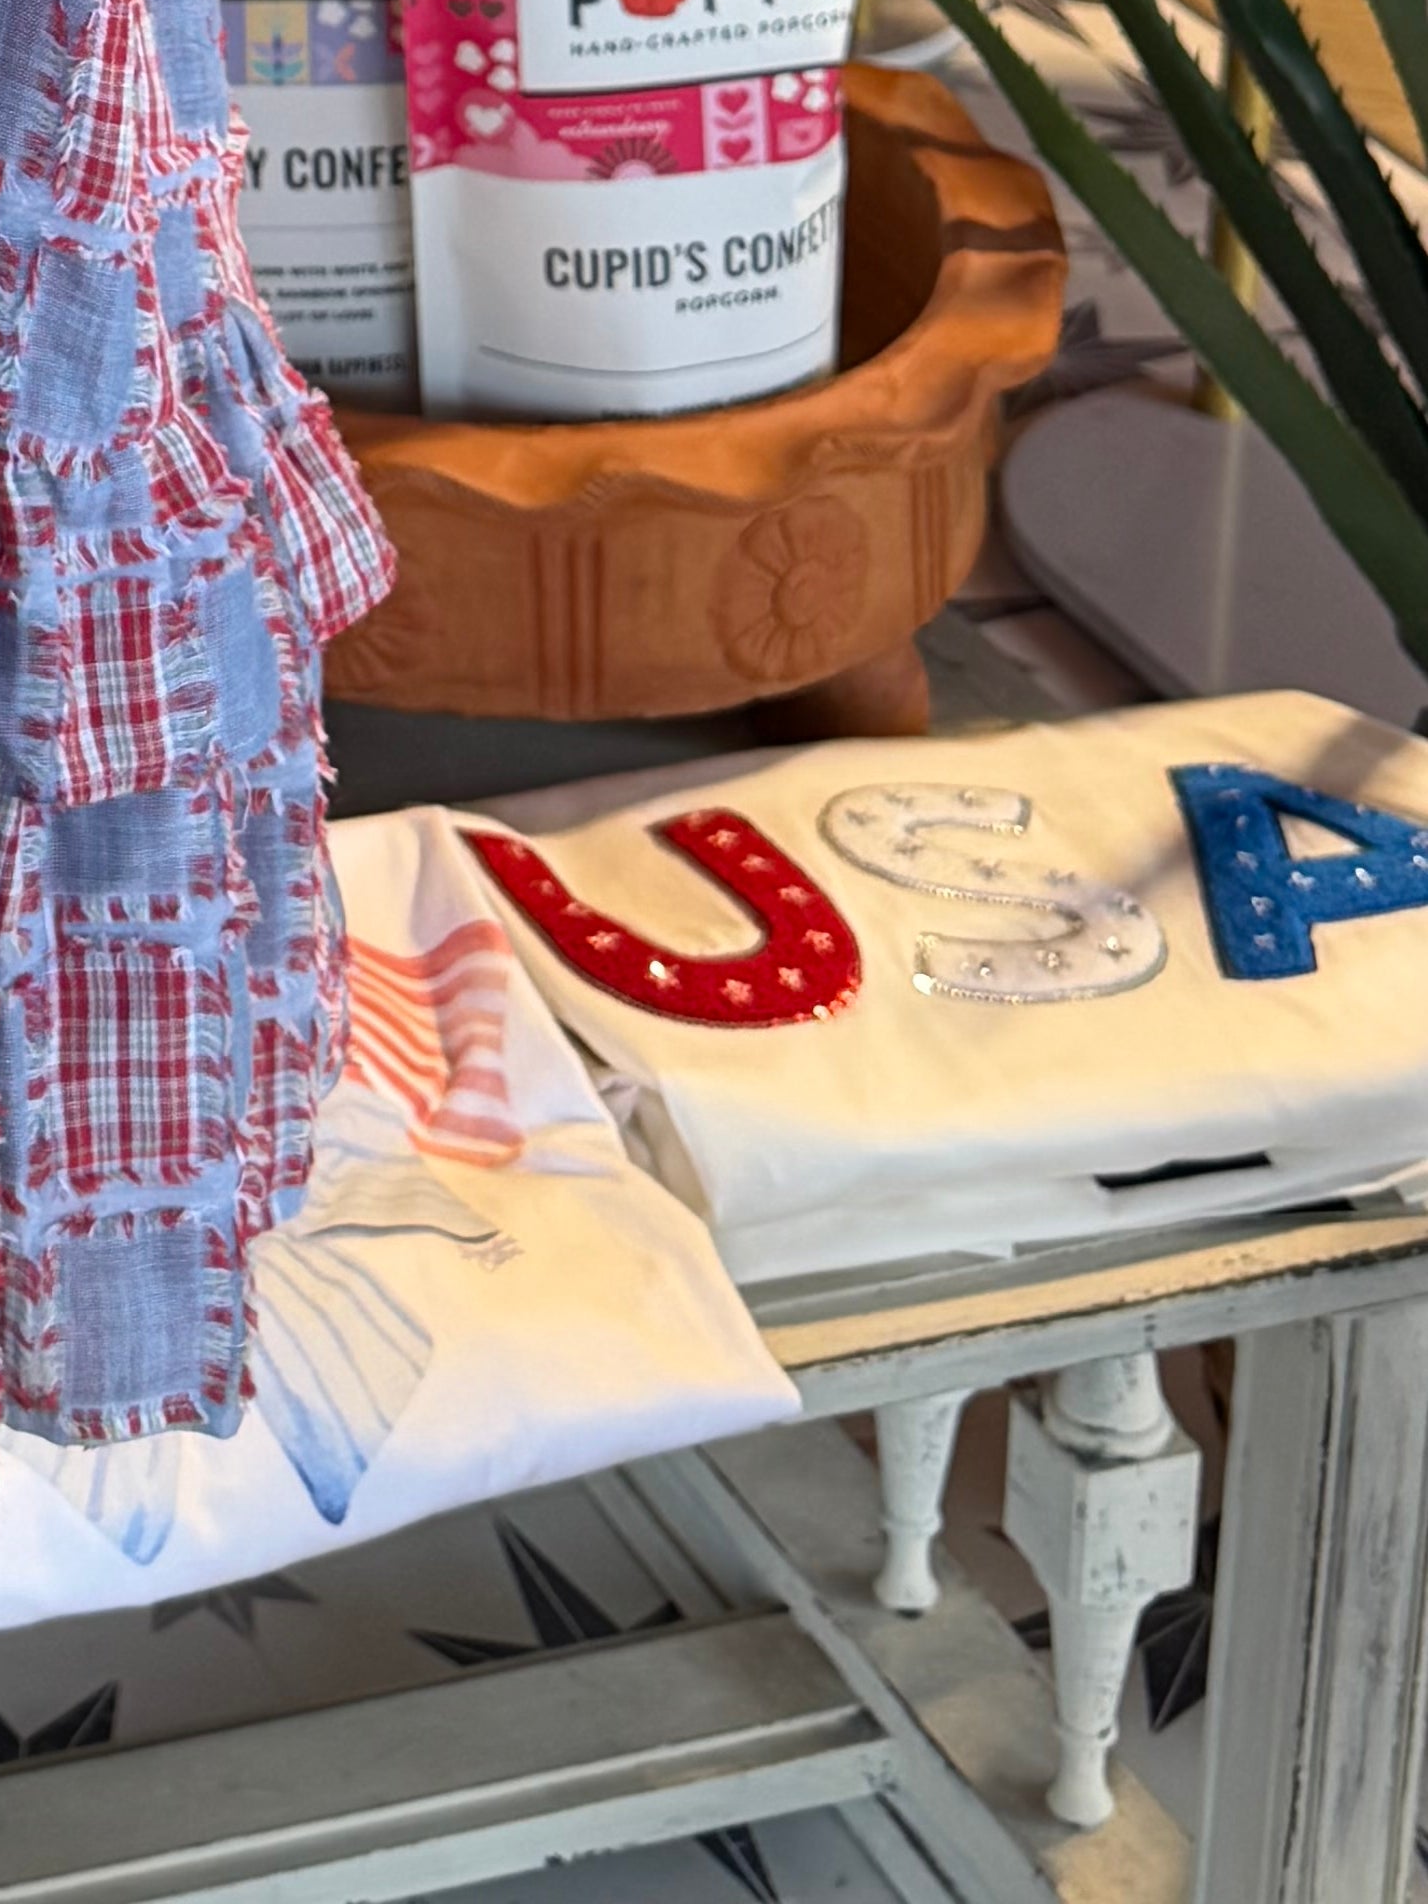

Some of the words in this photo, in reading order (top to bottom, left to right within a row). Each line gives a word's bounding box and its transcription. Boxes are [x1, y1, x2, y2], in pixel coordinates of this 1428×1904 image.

[569, 22, 749, 60] HAND-CRAFTED
[284, 144, 409, 191] CONFE
[543, 239, 710, 292] CUPID'S
[455, 764, 1428, 1028] USA
